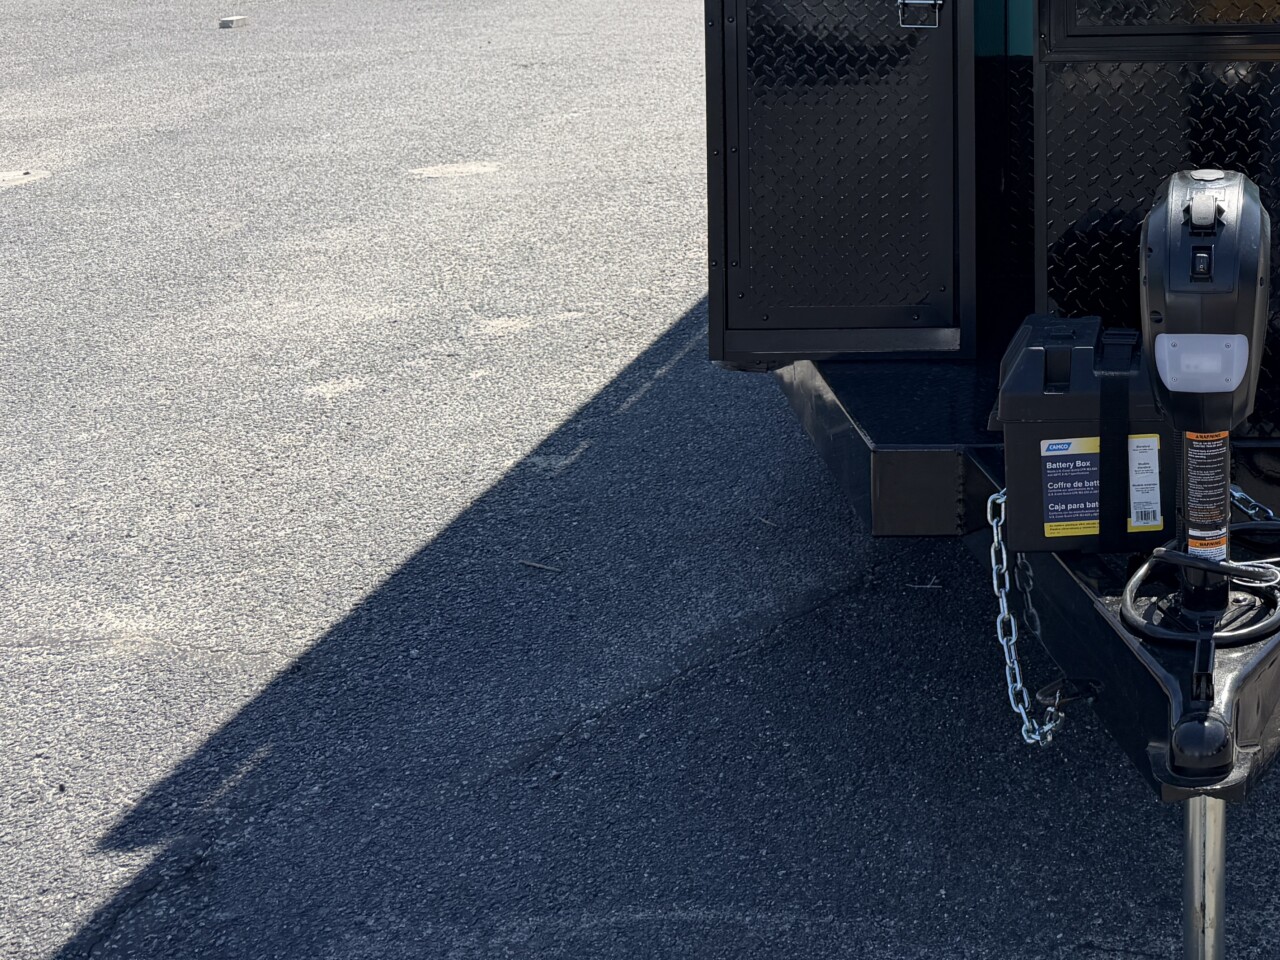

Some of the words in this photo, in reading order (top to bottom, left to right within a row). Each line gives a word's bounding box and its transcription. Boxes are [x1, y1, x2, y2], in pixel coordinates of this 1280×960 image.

[1046, 461, 1075, 470] Battery
[1075, 460, 1091, 468] Box
[1047, 481, 1072, 489] Coffre
[1073, 480, 1083, 488] de
[1048, 502, 1066, 511] Caja
[1067, 502, 1085, 511] para
